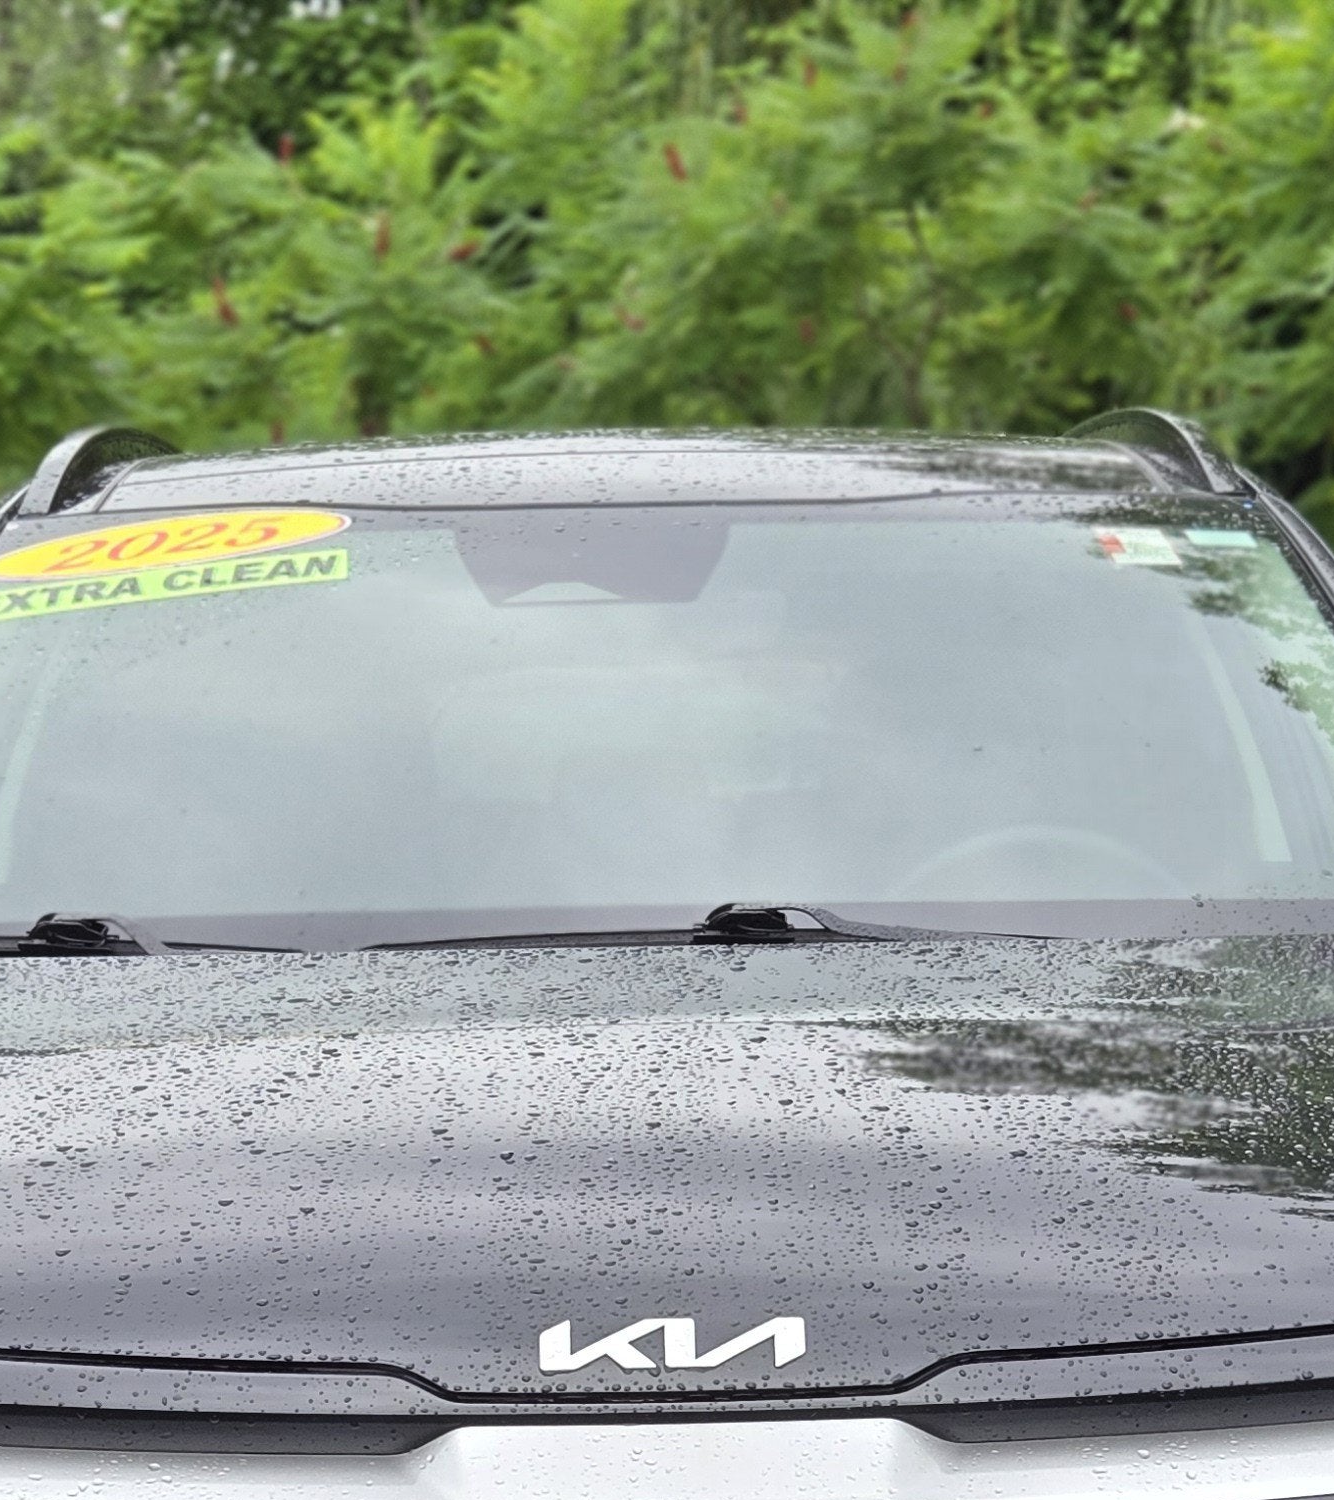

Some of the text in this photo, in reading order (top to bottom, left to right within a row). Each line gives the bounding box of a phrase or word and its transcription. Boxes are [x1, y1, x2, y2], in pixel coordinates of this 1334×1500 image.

[44, 517, 282, 573] 2025
[163, 554, 338, 592] CLEAN
[539, 1316, 806, 1371] KIA
